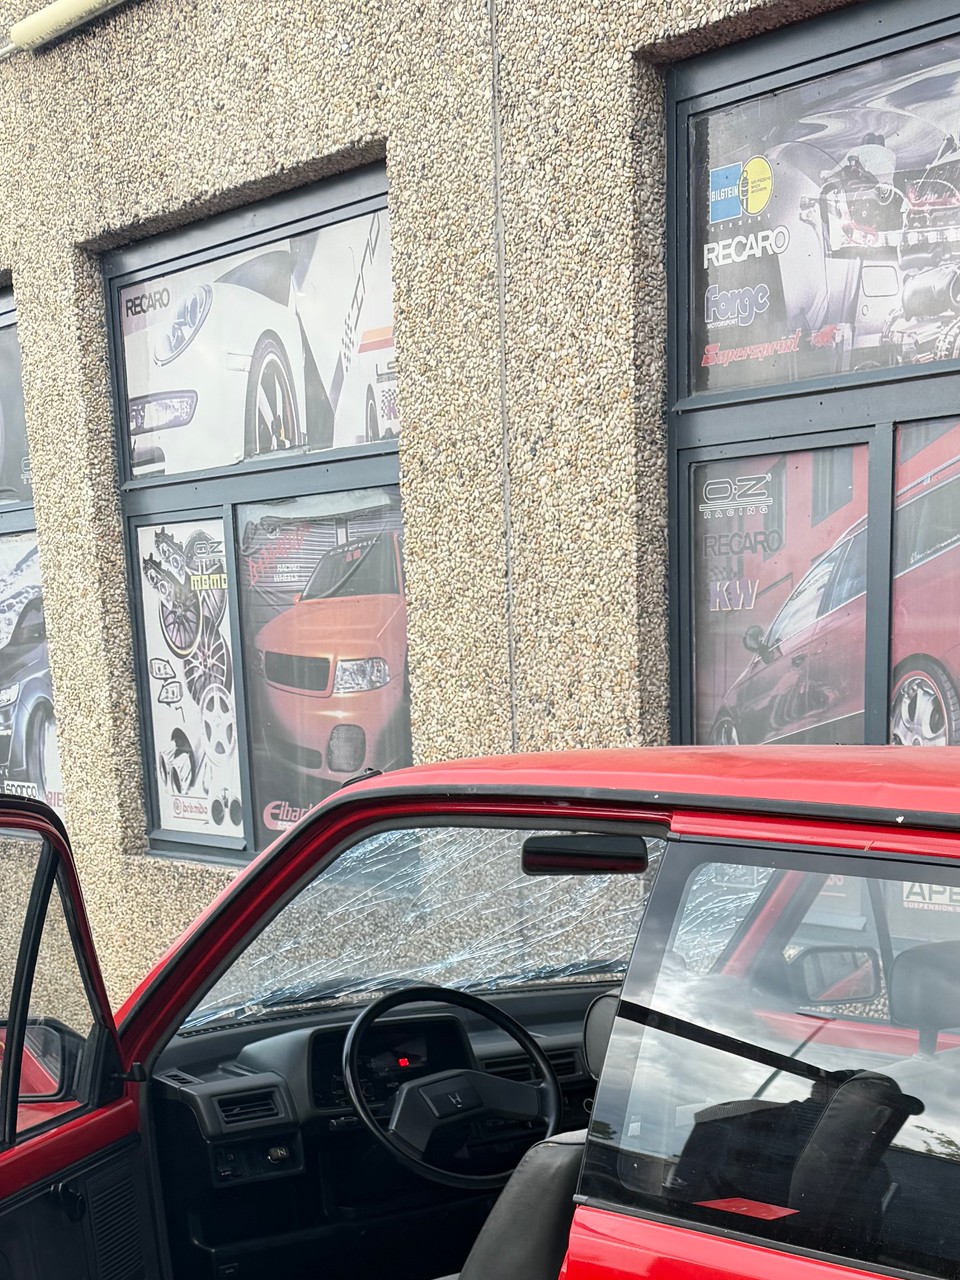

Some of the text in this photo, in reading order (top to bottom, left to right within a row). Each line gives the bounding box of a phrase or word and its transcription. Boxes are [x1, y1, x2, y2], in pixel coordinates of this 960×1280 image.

[711, 185, 739, 201] BILSTEIN
[703, 225, 790, 269] RECARO
[125, 287, 170, 318] RECARO
[704, 506, 768, 519] RACING
[702, 528, 783, 558] RECARO
[708, 579, 759, 611] KW
[903, 901, 953, 912] SUSPENSION
